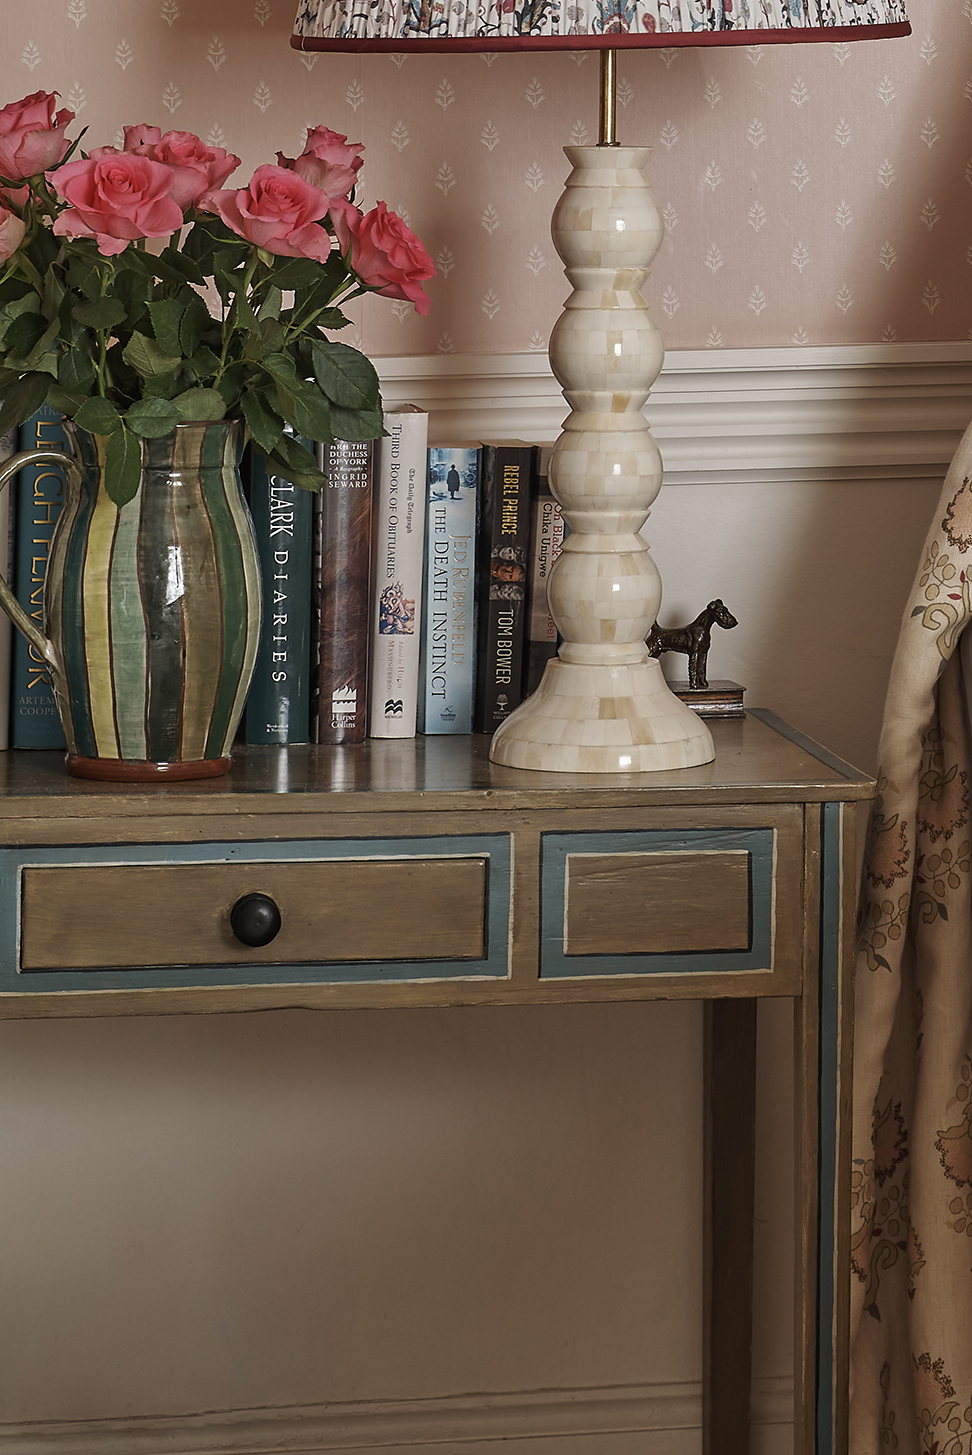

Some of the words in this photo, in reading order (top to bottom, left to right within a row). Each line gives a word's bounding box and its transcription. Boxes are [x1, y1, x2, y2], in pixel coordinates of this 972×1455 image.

[390, 423, 403, 459] THIRD
[328, 480, 368, 488] SEWARD
[329, 473, 368, 481] INGRID
[389, 463, 401, 494] BOOK
[407, 483, 415, 501] Daily
[502, 465, 520, 496] REBEL
[388, 497, 398, 512] OF
[405, 501, 415, 534] Telegraph
[501, 498, 519, 535] PRINCE
[541, 502, 553, 534] Chika
[434, 507, 447, 534] THE
[386, 515, 399, 579] OBITUARIES
[448, 534, 472, 563] JED
[551, 525, 563, 556] Black
[433, 540, 449, 602] DEATH
[538, 537, 551, 578] Unigwe
[272, 550, 289, 683] DIARIES
[451, 567, 470, 665] RUBENFELD
[497, 609, 514, 636] TOM
[431, 611, 448, 700] INSTINCT
[495, 640, 513, 684] BOWER
[20, 696, 55, 705] ARTEM
[20, 707, 57, 716] COOPE
[332, 713, 357, 722] Harper
